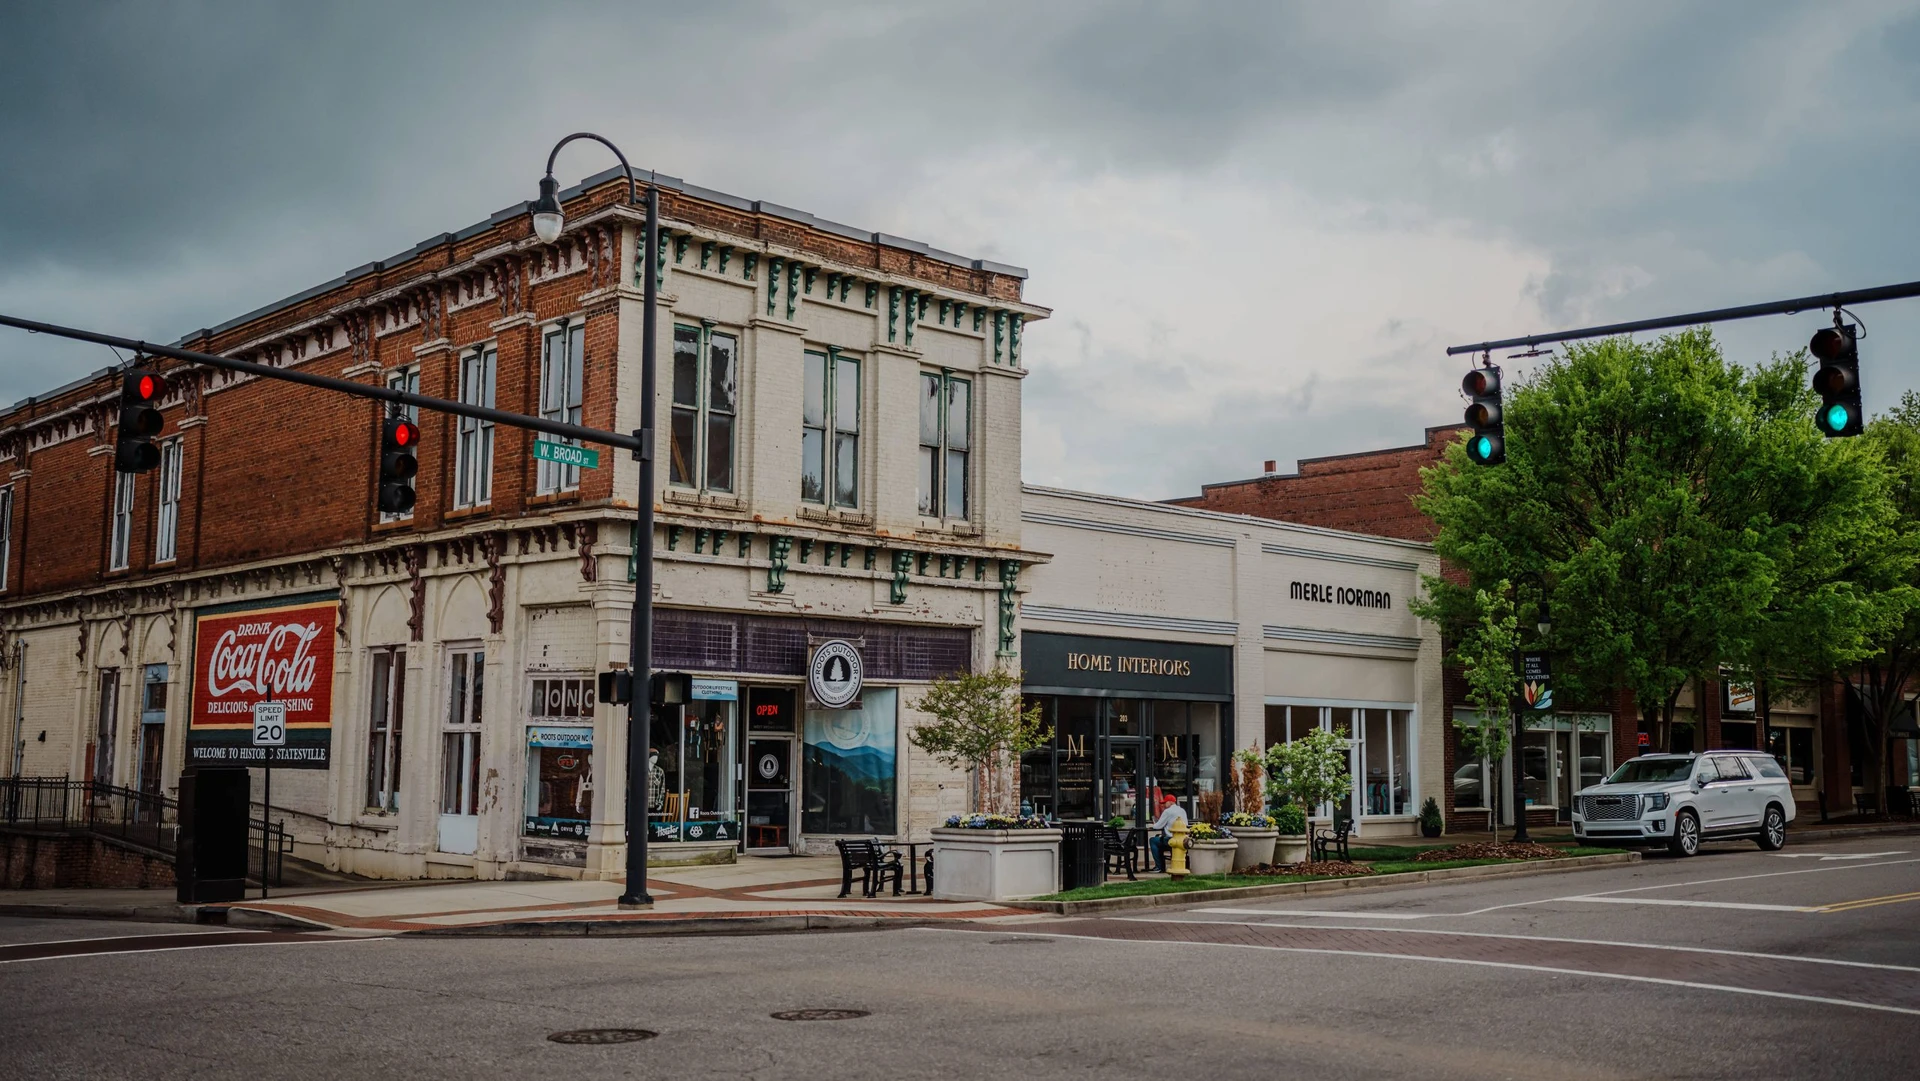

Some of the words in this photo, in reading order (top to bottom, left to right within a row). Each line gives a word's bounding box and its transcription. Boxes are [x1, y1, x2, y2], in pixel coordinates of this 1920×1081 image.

[540, 443, 550, 458] W.
[554, 447, 582, 463] BROAD
[1290, 581, 1332, 603] MERLE
[1337, 586, 1390, 609] NORMAN
[237, 622, 272, 636] DRINK
[816, 649, 830, 674] ROOTS
[832, 646, 858, 674] OUTDOOR
[1068, 653, 1112, 672] HOME
[1118, 656, 1191, 676] INTERIORS
[817, 682, 837, 700] DOWNTOWN
[838, 682, 856, 700] STATESVILLE
[208, 701, 248, 714] DELICIOUS
[756, 704, 778, 715] OPEN
[257, 725, 282, 740] 20
[194, 747, 226, 760] WELCOME
[229, 748, 238, 760] TO
[277, 748, 326, 760] STATESVILLE
